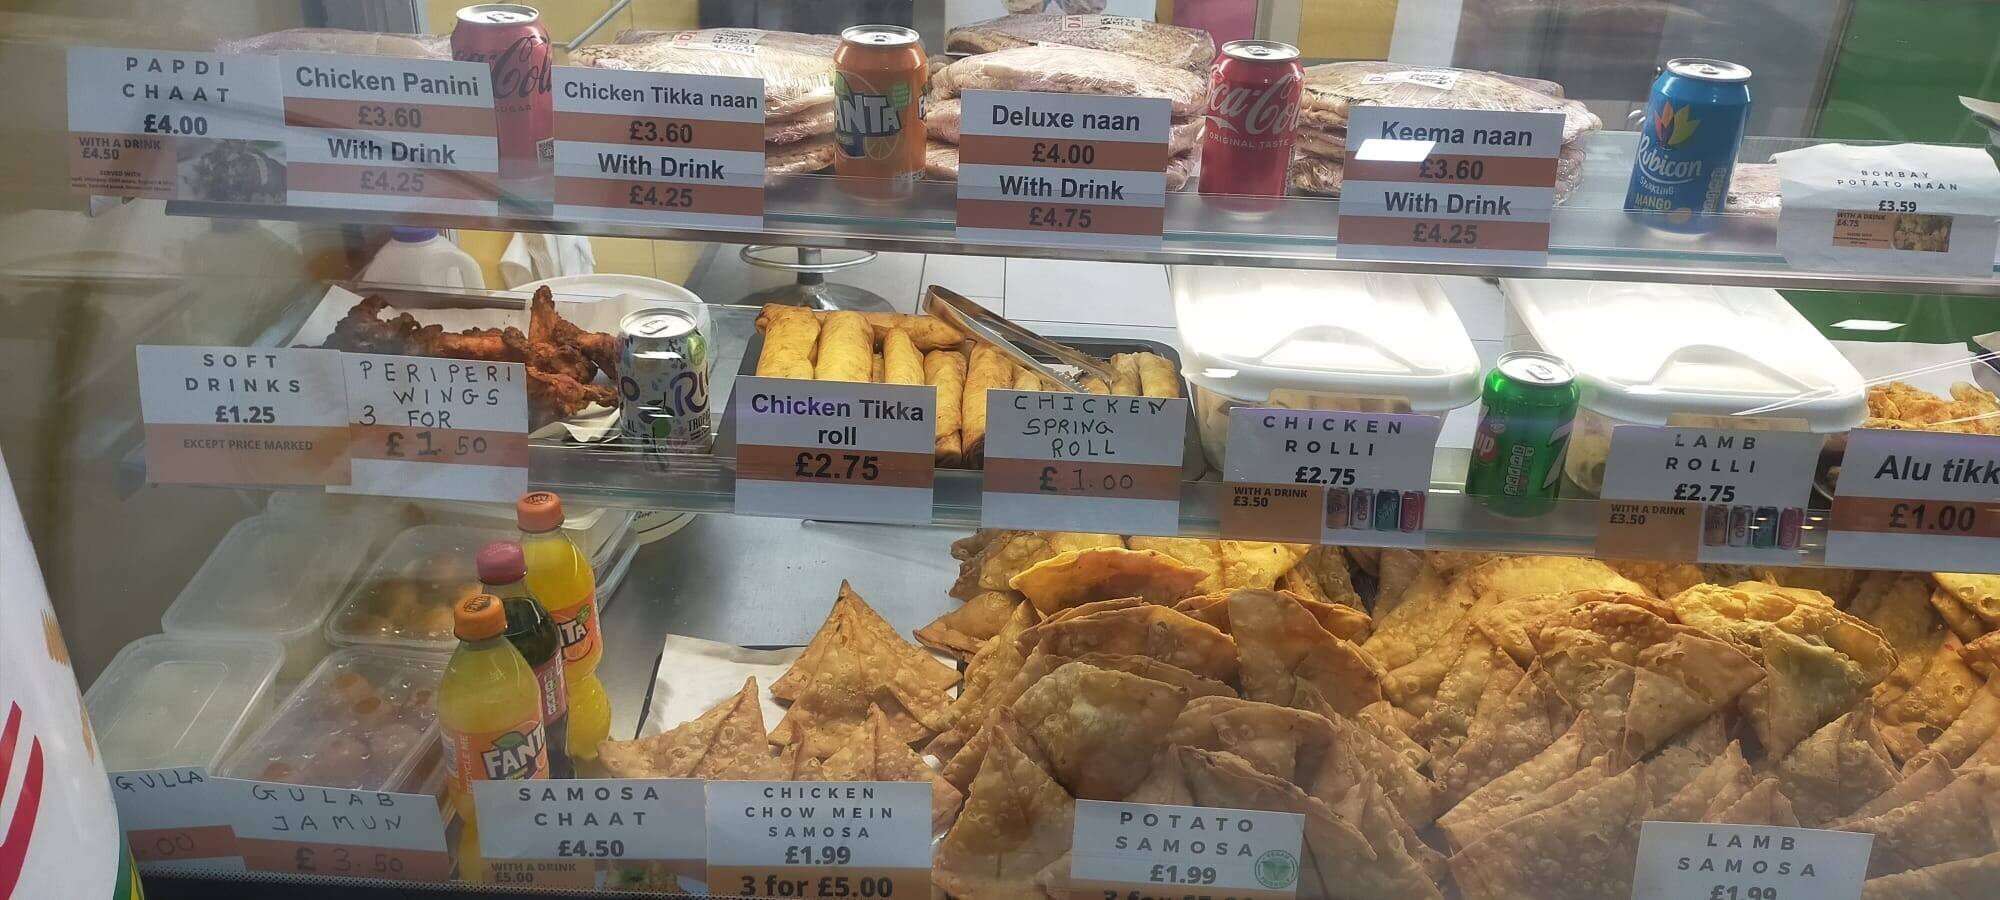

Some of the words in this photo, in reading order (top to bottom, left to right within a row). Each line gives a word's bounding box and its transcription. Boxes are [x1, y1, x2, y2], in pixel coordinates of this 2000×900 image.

[126, 57, 226, 76] PAPDI
[296, 66, 396, 92] Chicken
[402, 71, 479, 96] Panini
[122, 83, 229, 103] CHAAT
[564, 81, 645, 102] Chicken
[650, 86, 704, 106] Tikka
[709, 94, 758, 110] naan
[358, 106, 422, 129] £3.60
[834, 94, 901, 134] ANTA
[991, 104, 1075, 129] Deluxe
[1082, 111, 1140, 132] naan
[144, 113, 208, 136] £4.00
[629, 120, 693, 143] £3.60
[1381, 121, 1464, 144] Keema
[1472, 128, 1532, 147] naan
[80, 137, 109, 147] WITH
[113, 138, 120, 148] A
[124, 139, 160, 150] DRINK
[1209, 131, 1256, 148] ORIGINAL
[1261, 138, 1289, 148] TASTE
[82, 148, 119, 160] £4.50
[328, 136, 383, 162] With
[391, 140, 456, 165] Drink
[1031, 143, 1095, 165] £4.00
[1639, 134, 1702, 177] Rubicon
[598, 152, 653, 175] With
[660, 156, 724, 180] Drink
[1419, 158, 1484, 180] £3.60
[1860, 170, 1930, 179] BOMBAY
[360, 170, 424, 194] £4.25
[999, 174, 1051, 197] With
[1060, 177, 1125, 201] Drink
[1837, 178, 1902, 189] POTATO
[1913, 182, 1958, 192] NAAN
[629, 185, 693, 208] £4.25
[1385, 191, 1438, 212] With
[1446, 193, 1511, 216] Drink
[1635, 193, 1672, 211] MANGO
[1878, 200, 1917, 213] £3.59
[1029, 206, 1092, 229] £4.75
[1412, 222, 1478, 244] £4.25
[202, 353, 278, 368] SOFT
[185, 376, 301, 393] DRINKS
[393, 387, 500, 405] WINGS
[1014, 395, 1166, 415] CHICKEN
[215, 405, 275, 424] £1.25
[359, 404, 377, 426] 3
[407, 410, 452, 429] FOR
[751, 393, 850, 417] Chicken
[858, 399, 924, 421] Tikka
[1022, 418, 1114, 435] SPRING
[1263, 416, 1402, 434] CHICKEN
[183, 438, 226, 450] EXCEPT
[228, 439, 263, 450] PRICE
[264, 439, 313, 452] MARKED
[818, 426, 857, 446] roll
[1675, 434, 1756, 450] LAMB
[1052, 438, 1115, 458] ROLL
[1285, 440, 1374, 456] ROLLI
[795, 452, 879, 480] £2.75
[1665, 457, 1755, 474] ROLLI
[1874, 455, 1931, 481] Alu
[1295, 467, 1356, 486] £2.75
[1233, 497, 1268, 507] £3.50
[1234, 487, 1262, 496] WITH
[1264, 488, 1272, 496] A
[1274, 488, 1307, 498] DRINK
[1674, 484, 1735, 503] £2.75
[1610, 513, 1645, 525] £3.50
[1611, 504, 1640, 514] WITH
[1641, 505, 1650, 514] A
[1652, 505, 1686, 515] DRINK
[1889, 503, 1975, 531] £1.00
[116, 769, 203, 792] GULLA
[253, 784, 395, 807] GULAB
[518, 786, 660, 802] SAMOSA
[764, 787, 875, 799] CHICKEN
[534, 811, 649, 826] CHAAT
[745, 806, 815, 818] CHOW
[832, 807, 894, 819] MEIN
[1120, 811, 1254, 832] POTATO
[272, 815, 401, 831] JAMUN
[768, 826, 871, 839] SAMOSA
[558, 839, 624, 857] £4.50
[1115, 836, 1253, 857] SAMOSA
[1707, 833, 1796, 850] LAMB
[785, 846, 851, 865] £1.99
[491, 863, 523, 872] WITH
[526, 864, 535, 872] A
[538, 863, 576, 872] DRINK
[1150, 864, 1217, 885] £1.99
[1677, 857, 1816, 877] SAMOSA
[495, 872, 534, 883] £5.00
[740, 875, 756, 896] 3
[764, 874, 809, 897] for
[818, 876, 893, 898] £5.00
